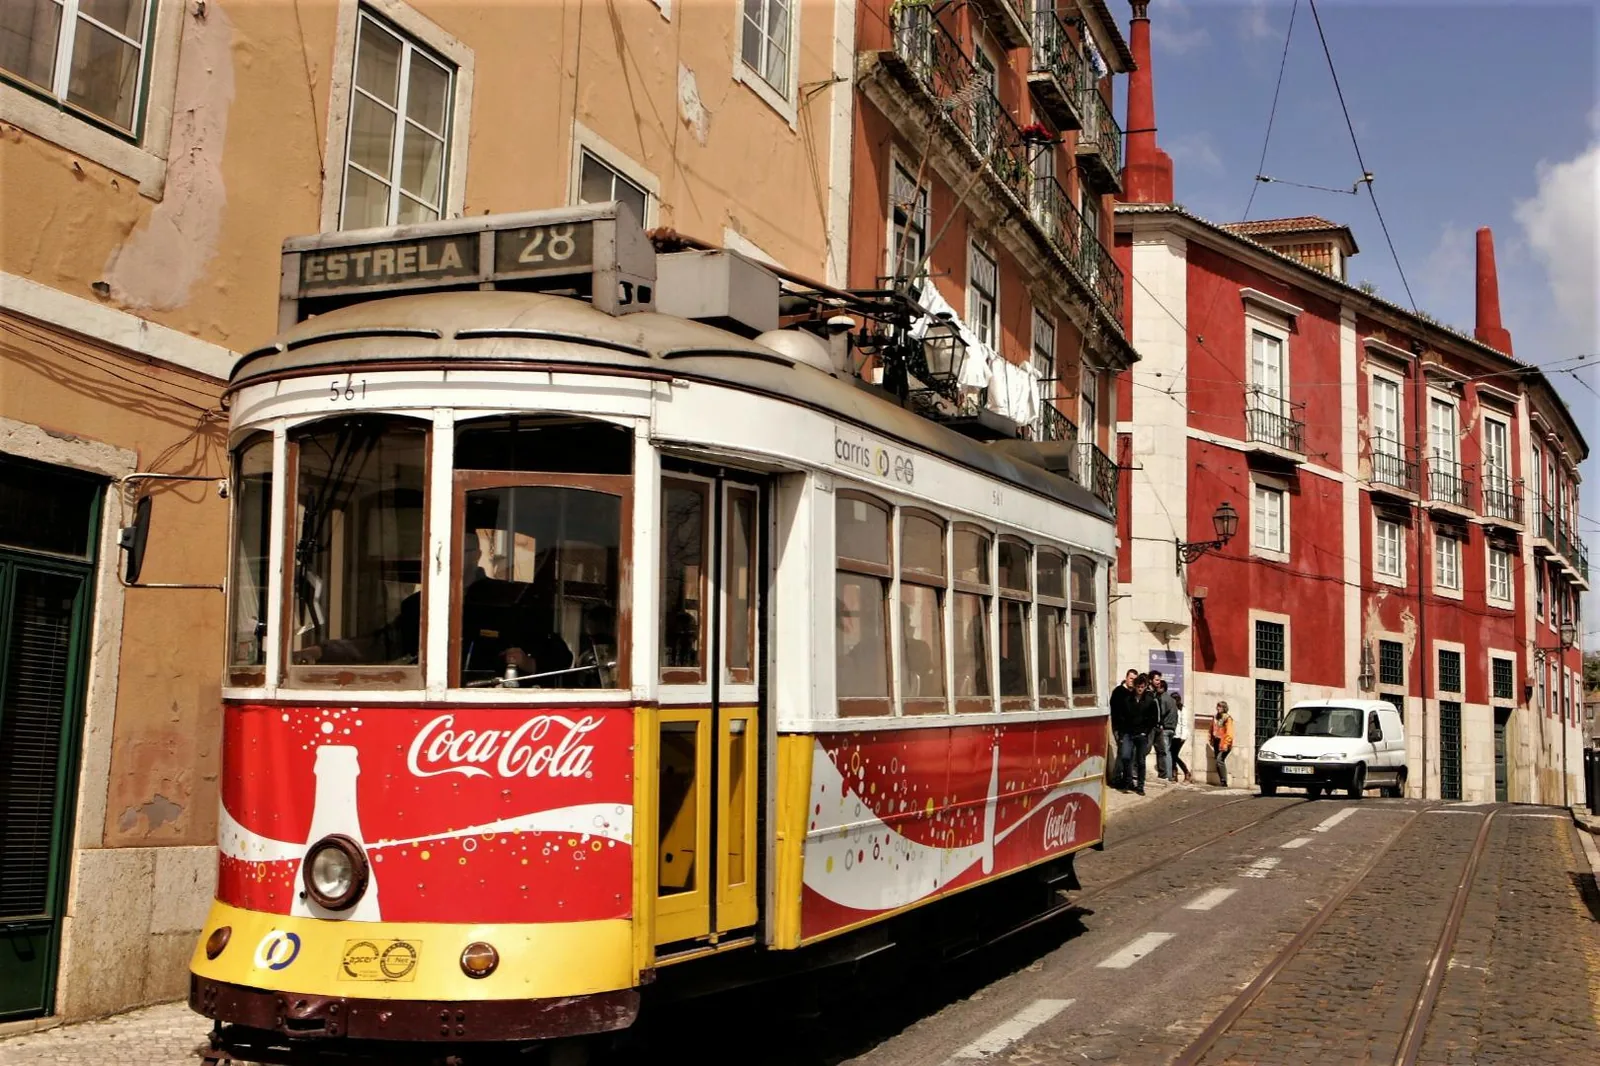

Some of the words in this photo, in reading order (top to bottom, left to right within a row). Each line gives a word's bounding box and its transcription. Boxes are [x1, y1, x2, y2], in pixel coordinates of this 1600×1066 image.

[304, 242, 464, 283] ESTRELA
[518, 224, 576, 263] 28
[329, 379, 368, 402] 561
[834, 436, 870, 468] carris
[406, 714, 605, 779] Coca-Cola
[1043, 801, 1080, 851] Coca-Cola
